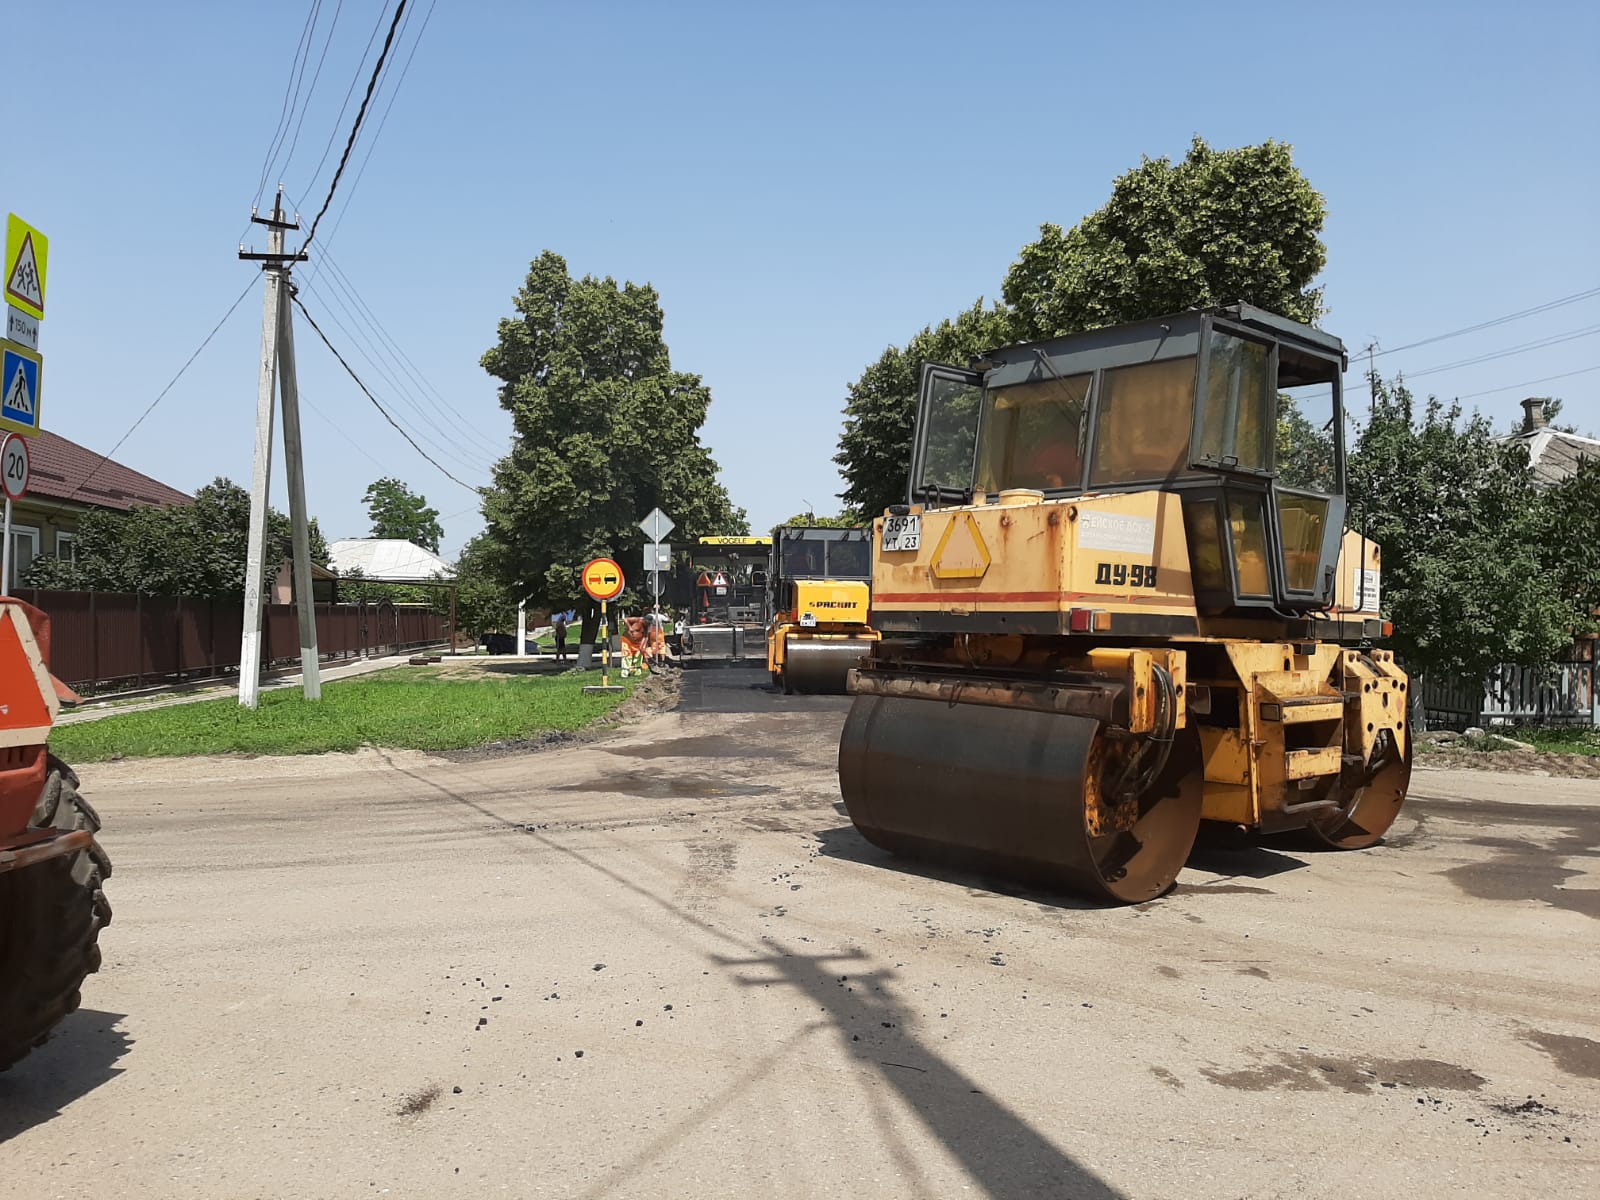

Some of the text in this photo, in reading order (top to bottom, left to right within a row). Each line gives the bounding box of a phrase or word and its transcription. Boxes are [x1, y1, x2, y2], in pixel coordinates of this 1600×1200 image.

[15, 318, 26, 335] 150
[7, 452, 24, 481] 20
[887, 516, 916, 532] 3691
[904, 536, 917, 549] 23
